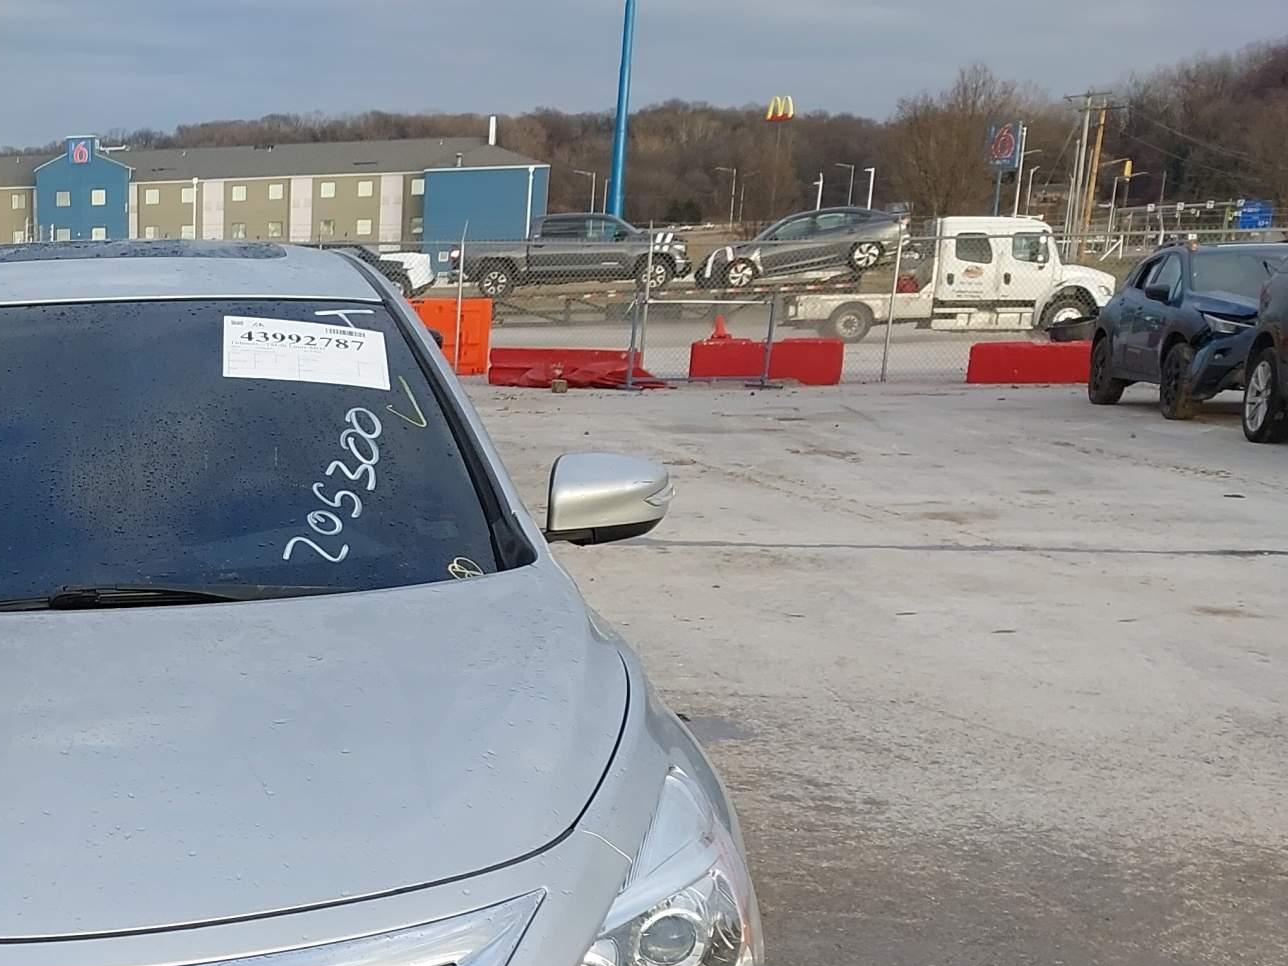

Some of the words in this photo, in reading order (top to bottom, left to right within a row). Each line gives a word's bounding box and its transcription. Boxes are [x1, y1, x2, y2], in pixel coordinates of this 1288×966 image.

[73, 141, 89, 164] 6
[992, 122, 1015, 160] 6
[240, 330, 365, 351] 43992787
[282, 407, 383, 563] 205300
